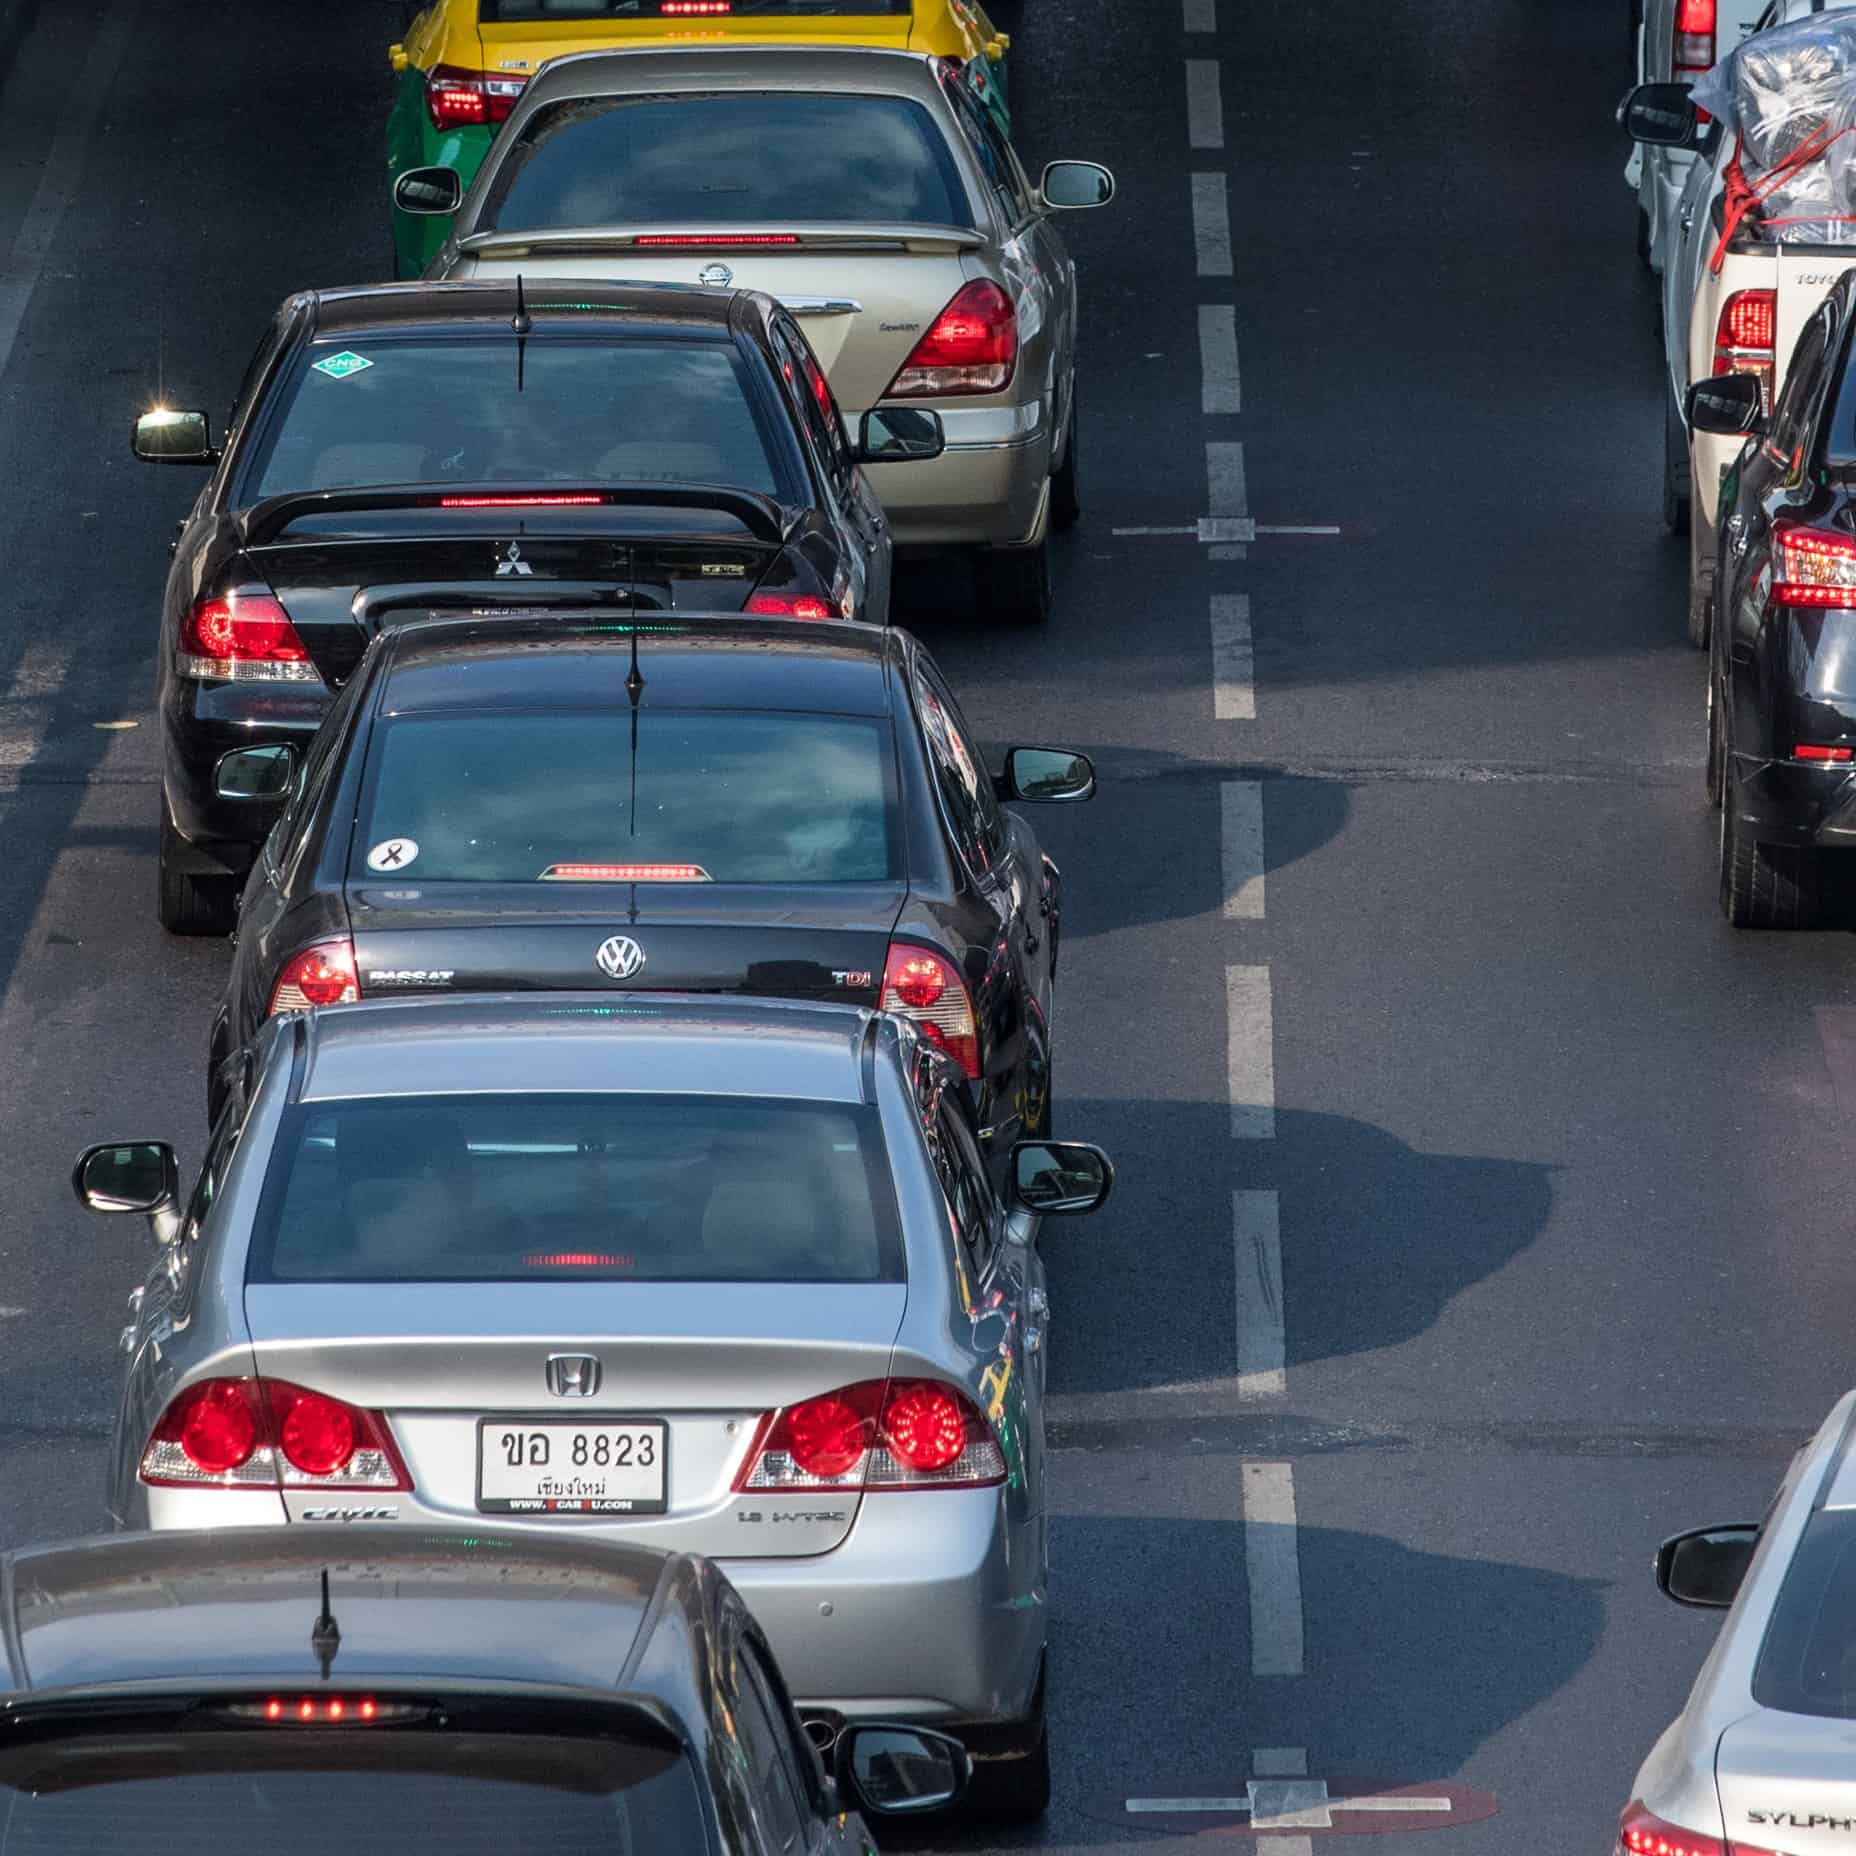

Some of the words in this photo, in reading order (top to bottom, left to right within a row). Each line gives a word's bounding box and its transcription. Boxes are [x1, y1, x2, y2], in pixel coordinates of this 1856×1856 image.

[831, 970, 872, 987] TDI
[571, 1433, 655, 1467] 8823
[537, 1476, 607, 1496] เชียงใหม่
[302, 1506, 400, 1522] CIVIC
